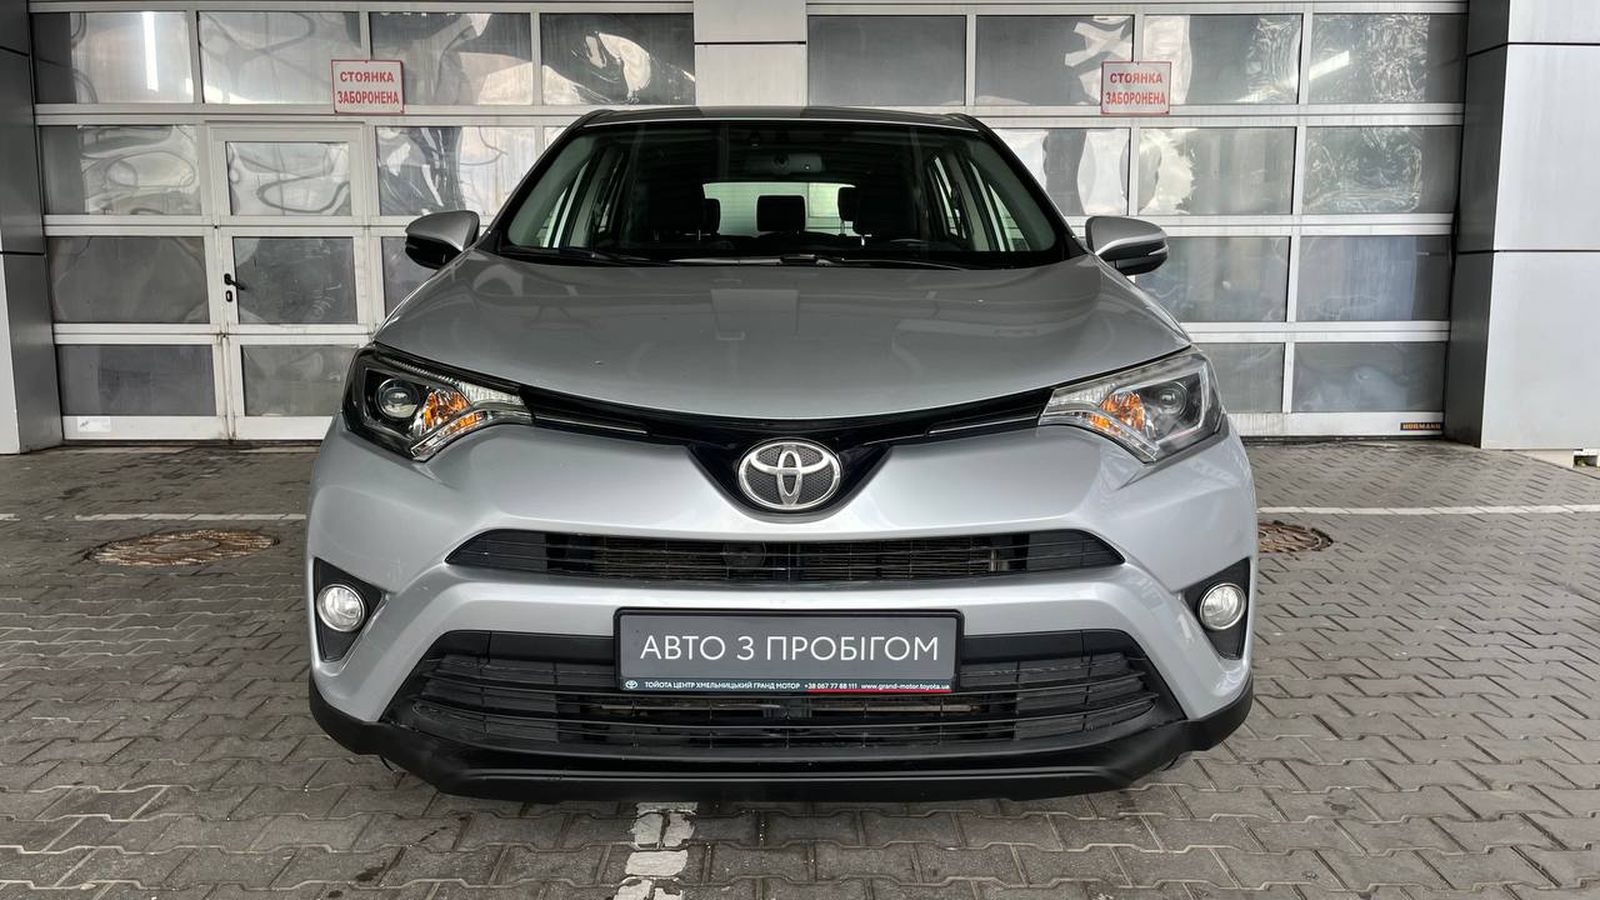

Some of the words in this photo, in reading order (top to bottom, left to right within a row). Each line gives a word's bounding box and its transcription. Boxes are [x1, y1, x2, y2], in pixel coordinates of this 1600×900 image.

[340, 71, 395, 82] СТОЯНКА
[1110, 73, 1162, 83] СТОЯНКА
[337, 91, 399, 104] ЗАБОРОНЕНА
[1105, 92, 1166, 105] ЗАБОРОНЕНА
[640, 635, 726, 661] АВТО
[766, 636, 939, 661] ПРОБІГОМ
[644, 681, 673, 689] ТОЙОТА
[673, 682, 695, 690] ЦЕНТР
[753, 682, 775, 690] ГРАНД
